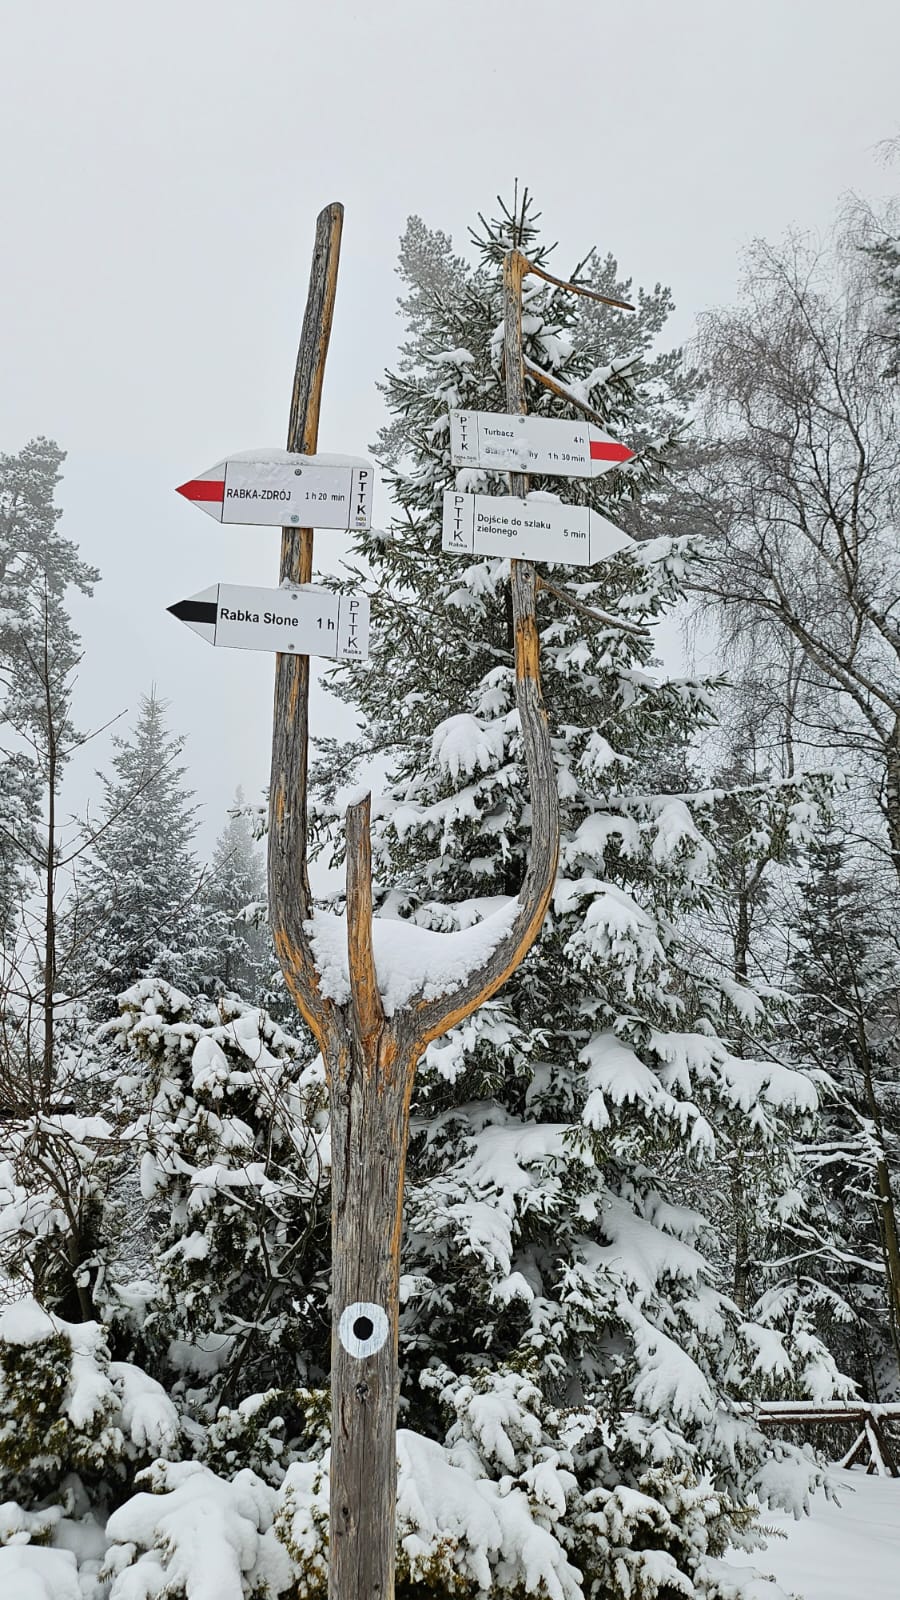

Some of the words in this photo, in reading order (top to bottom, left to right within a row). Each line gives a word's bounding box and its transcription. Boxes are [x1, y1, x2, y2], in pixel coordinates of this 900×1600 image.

[460, 416, 469, 451] PTTK
[484, 427, 515, 438] Turbacz
[579, 436, 585, 444] h
[548, 452, 553, 460] 1
[553, 452, 559, 460] h
[561, 453, 571, 461] 30
[571, 454, 586, 463] min
[226, 488, 292, 501] RABKA-ZDRÓJ
[305, 492, 310, 500] 1
[311, 492, 317, 500] h
[318, 492, 328, 501] 20
[331, 494, 345, 502] min
[356, 471, 368, 515] PTTK
[453, 496, 464, 542] PTTK
[477, 513, 509, 525] Dojście
[511, 517, 522, 527] do
[524, 519, 551, 530] szlaku
[476, 525, 518, 538] zielonego
[563, 529, 569, 538] 5
[570, 529, 586, 539] min
[220, 608, 260, 623] Rabka
[263, 612, 299, 627] Słone
[317, 617, 323, 630] 1
[327, 618, 335, 630] h
[348, 601, 360, 648] PTTK
